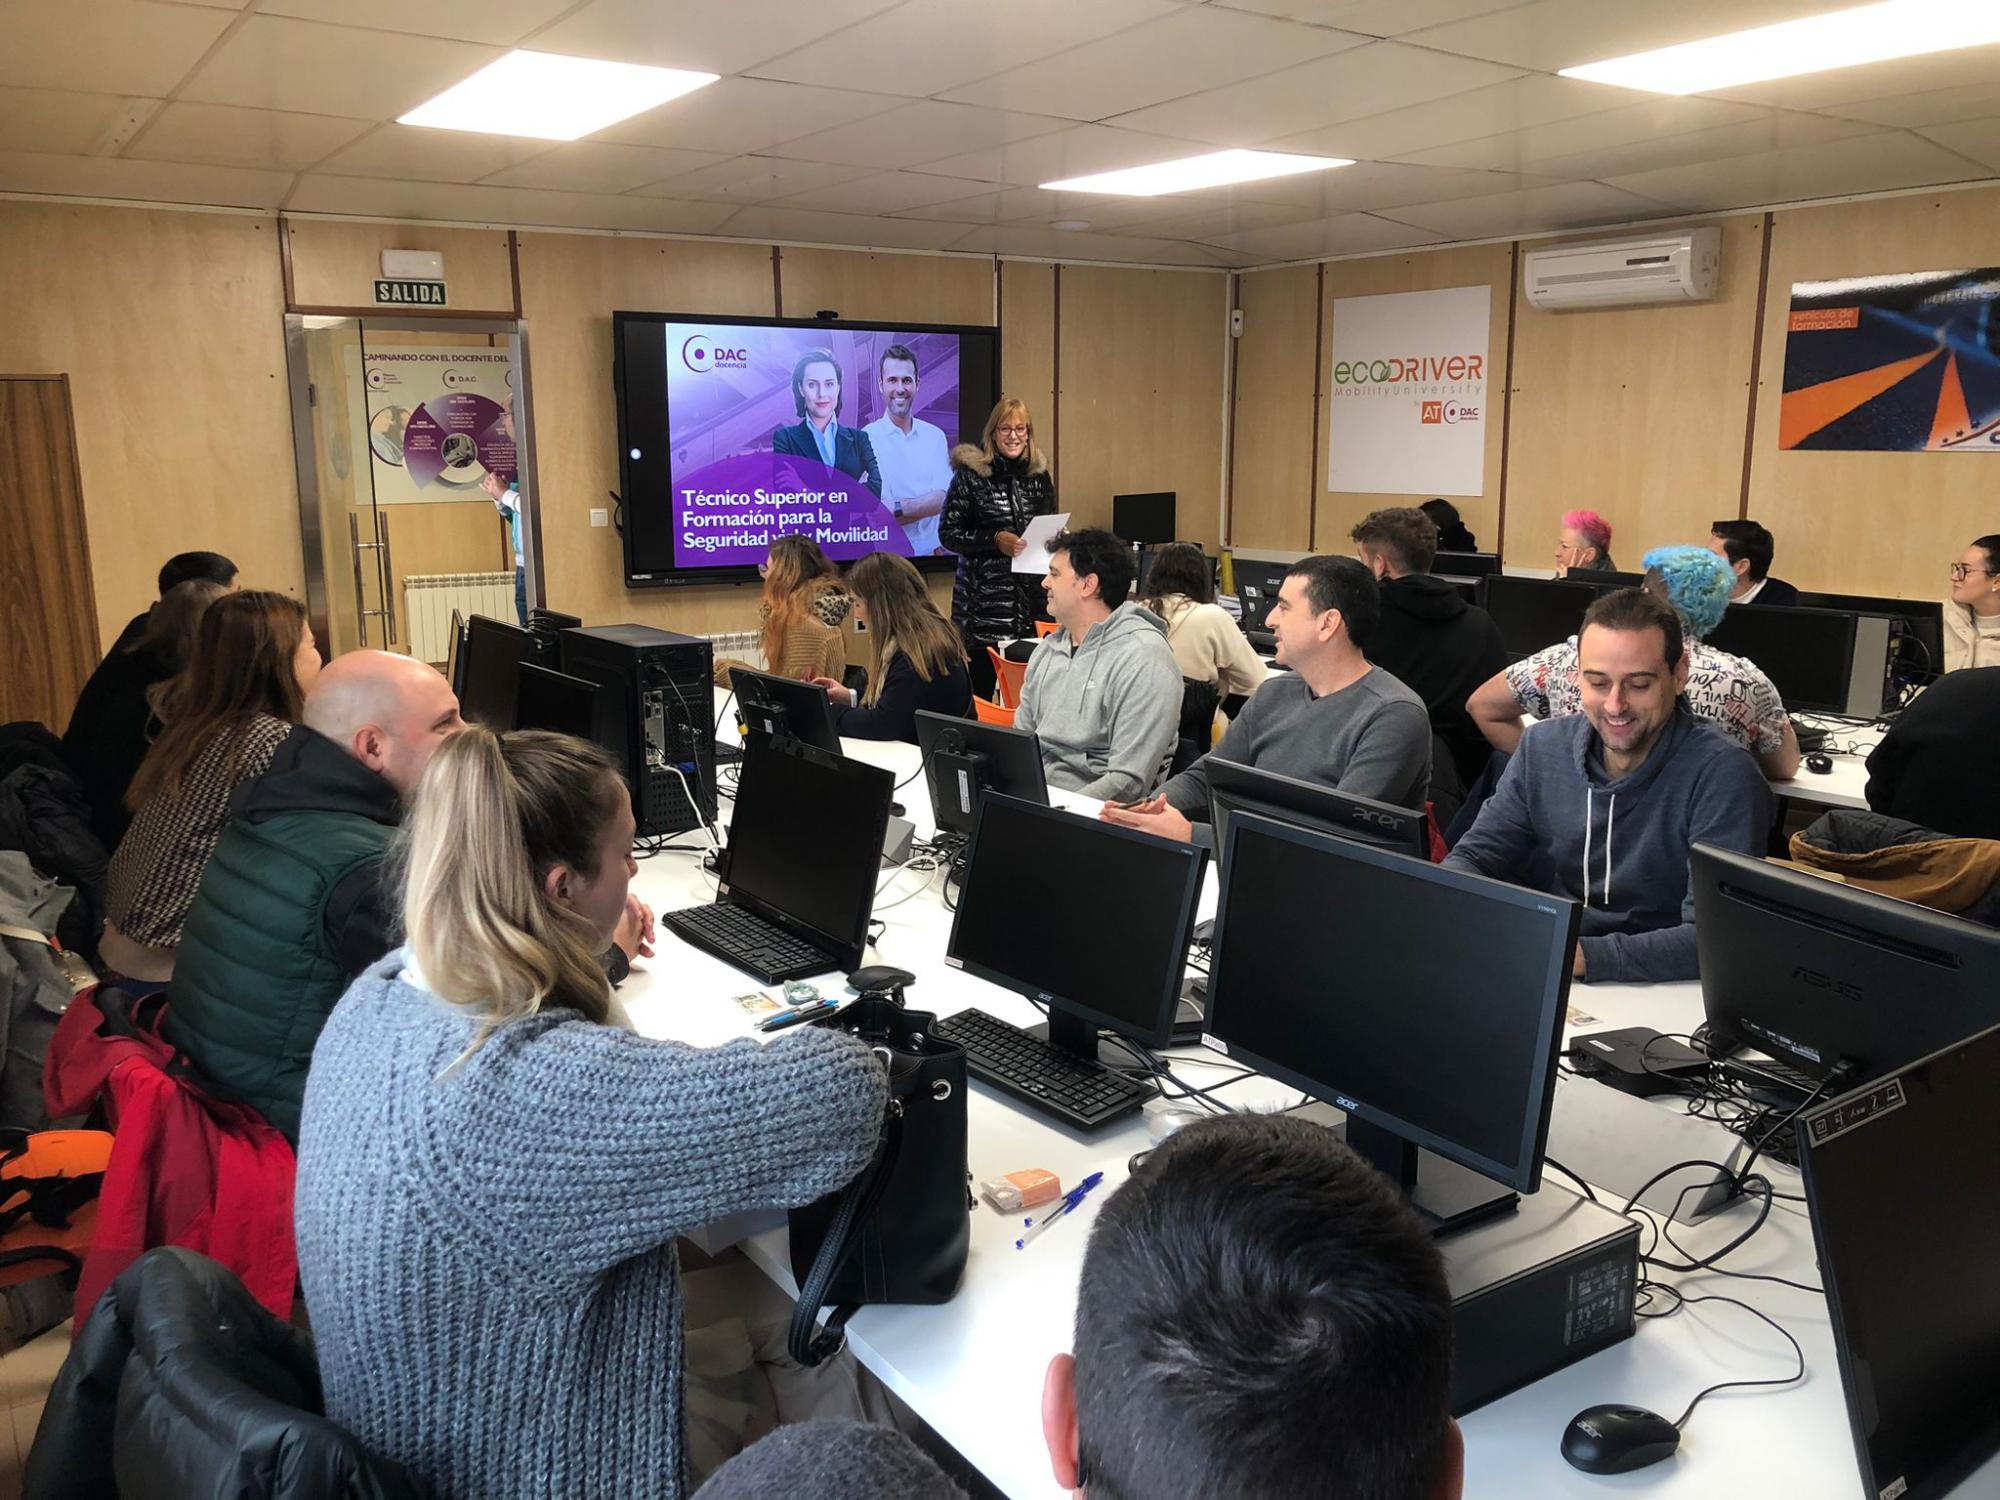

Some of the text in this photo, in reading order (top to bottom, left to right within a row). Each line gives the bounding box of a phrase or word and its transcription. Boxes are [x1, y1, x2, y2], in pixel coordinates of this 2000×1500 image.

[379, 282, 443, 304] SALIDA
[1838, 308, 1854, 318] de
[419, 354, 440, 362] CON
[441, 354, 450, 362] EL
[451, 354, 493, 363] DOCENTE
[493, 354, 509, 363] DEL
[714, 348, 747, 362] DAC
[714, 361, 747, 369] docencia
[1423, 405, 1479, 420] AT DAC
[681, 488, 848, 511] Técnico Superior en
[682, 507, 832, 529] Formación para la
[683, 531, 768, 553] Seguridad
[815, 525, 889, 543] Movilidad
[1791, 967, 1863, 1001] ASUS
[1037, 992, 1053, 1002] acer
[1336, 1095, 1359, 1111] acer
[1576, 1420, 1603, 1439] acer
